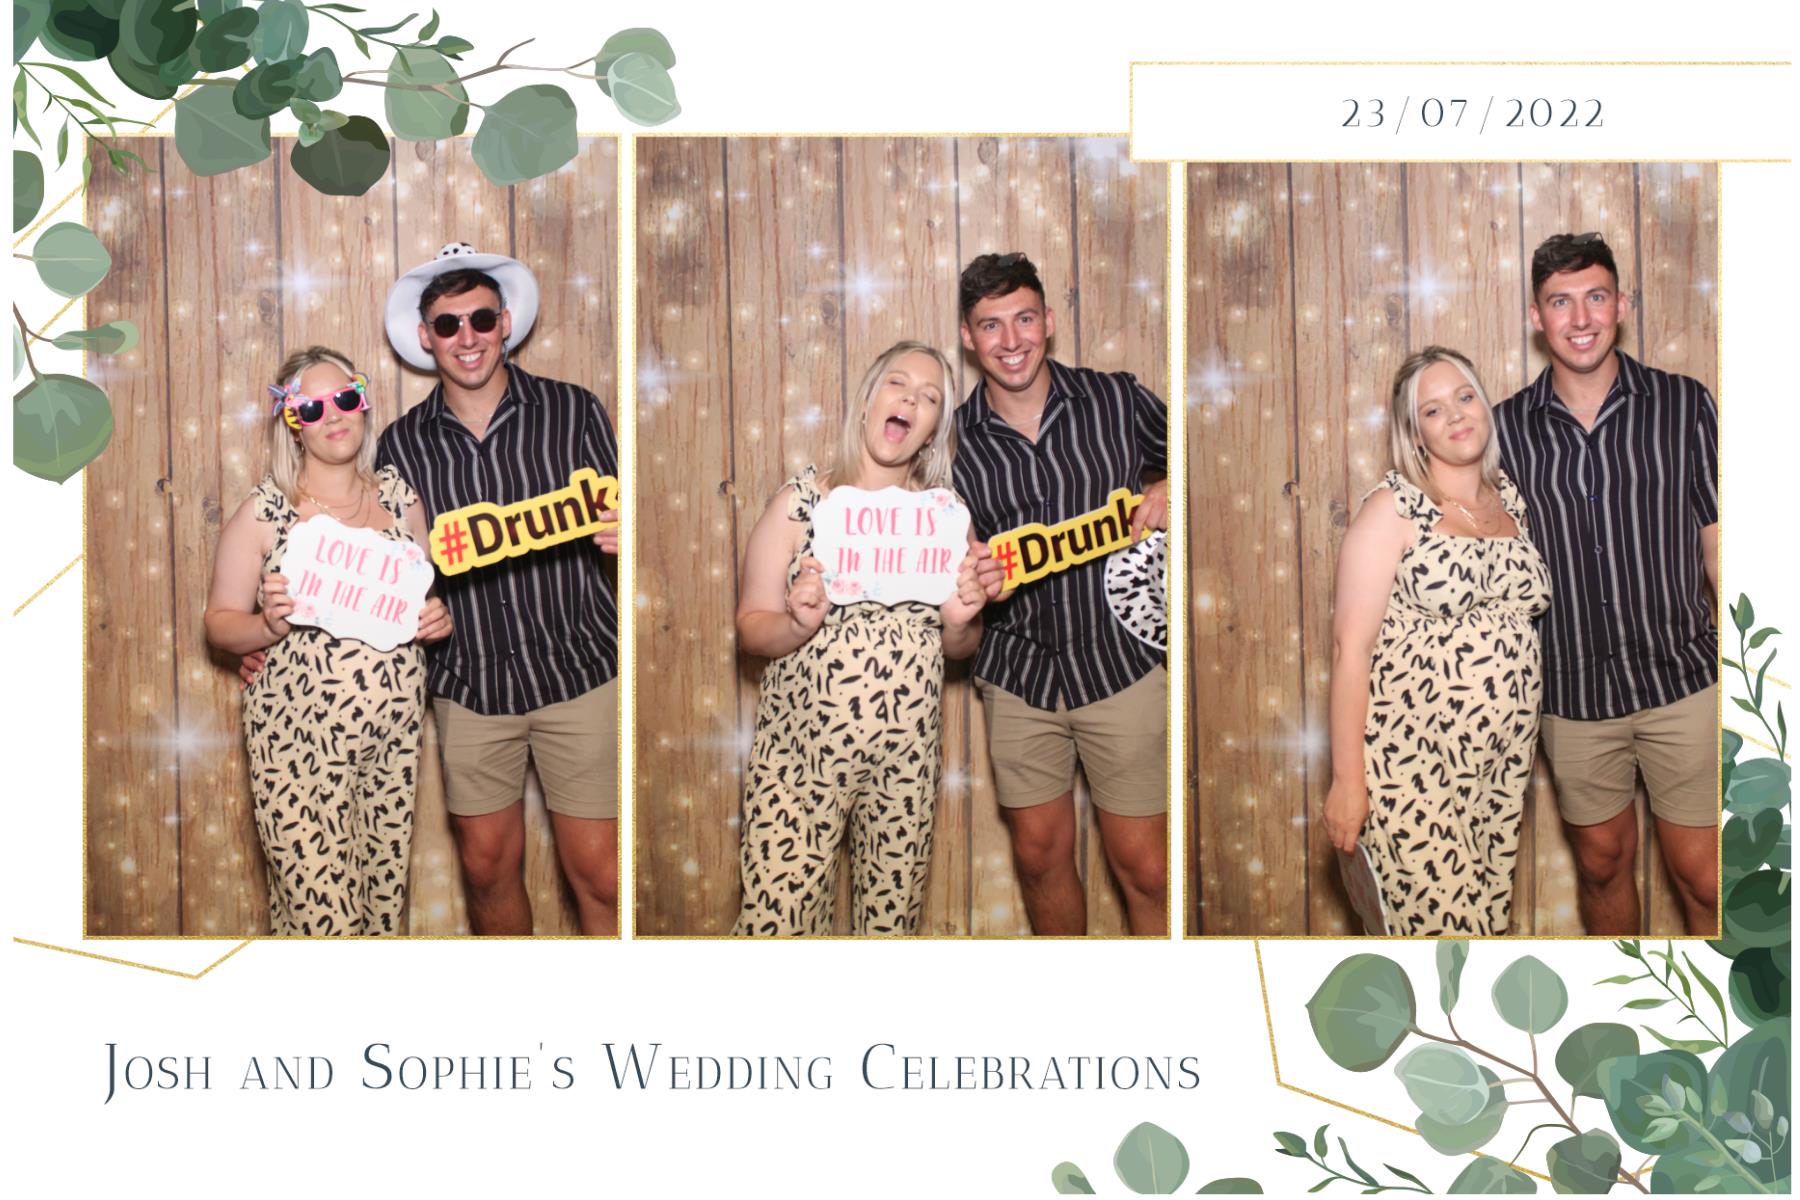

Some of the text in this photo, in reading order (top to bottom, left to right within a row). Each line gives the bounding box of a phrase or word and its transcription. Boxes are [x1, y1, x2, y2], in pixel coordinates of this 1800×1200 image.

[439, 478, 617, 566] #Drunk
[845, 507, 936, 537] LOVE IS
[315, 534, 402, 585] LOVE IS
[873, 547, 909, 574] THE
[916, 547, 952, 575] AIR
[331, 578, 366, 612] THE
[371, 594, 408, 625] AIR
